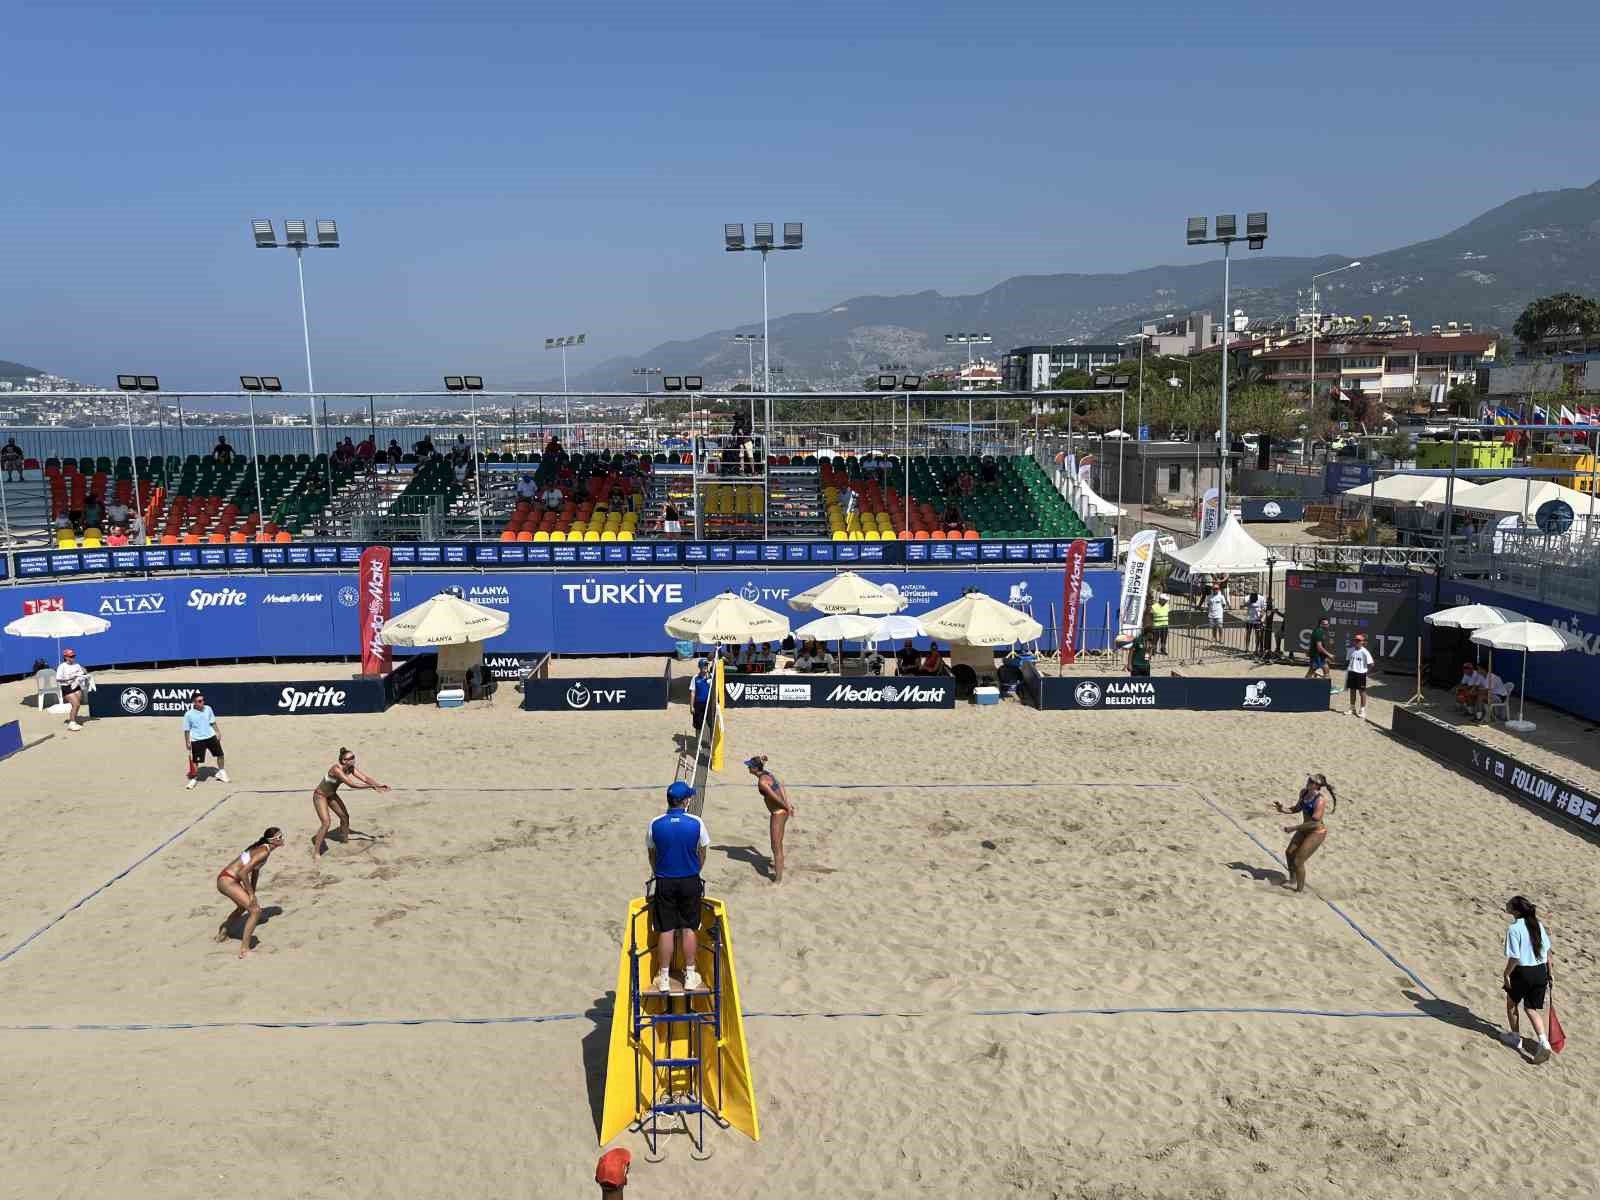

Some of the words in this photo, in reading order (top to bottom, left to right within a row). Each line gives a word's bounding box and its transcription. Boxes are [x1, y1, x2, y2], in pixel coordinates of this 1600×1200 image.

[1132, 562, 1144, 594] BEACH
[470, 586, 509, 595] ALANYA
[562, 579, 684, 604] TÜRKİYE
[762, 588, 791, 600] TVF
[99, 597, 164, 612] ALTAV
[187, 587, 247, 610] Sprite
[1375, 634, 1404, 656] 17
[484, 657, 520, 667] LANYA
[744, 686, 778, 694] BEACH
[826, 684, 882, 701] Media
[896, 685, 946, 701] Markt
[1106, 683, 1155, 693] ALANYA
[278, 686, 346, 712] Sprite
[592, 690, 627, 703] TVF
[1105, 693, 1155, 705] BELEDİYESİ
[1511, 767, 1557, 802] FOLLOW
